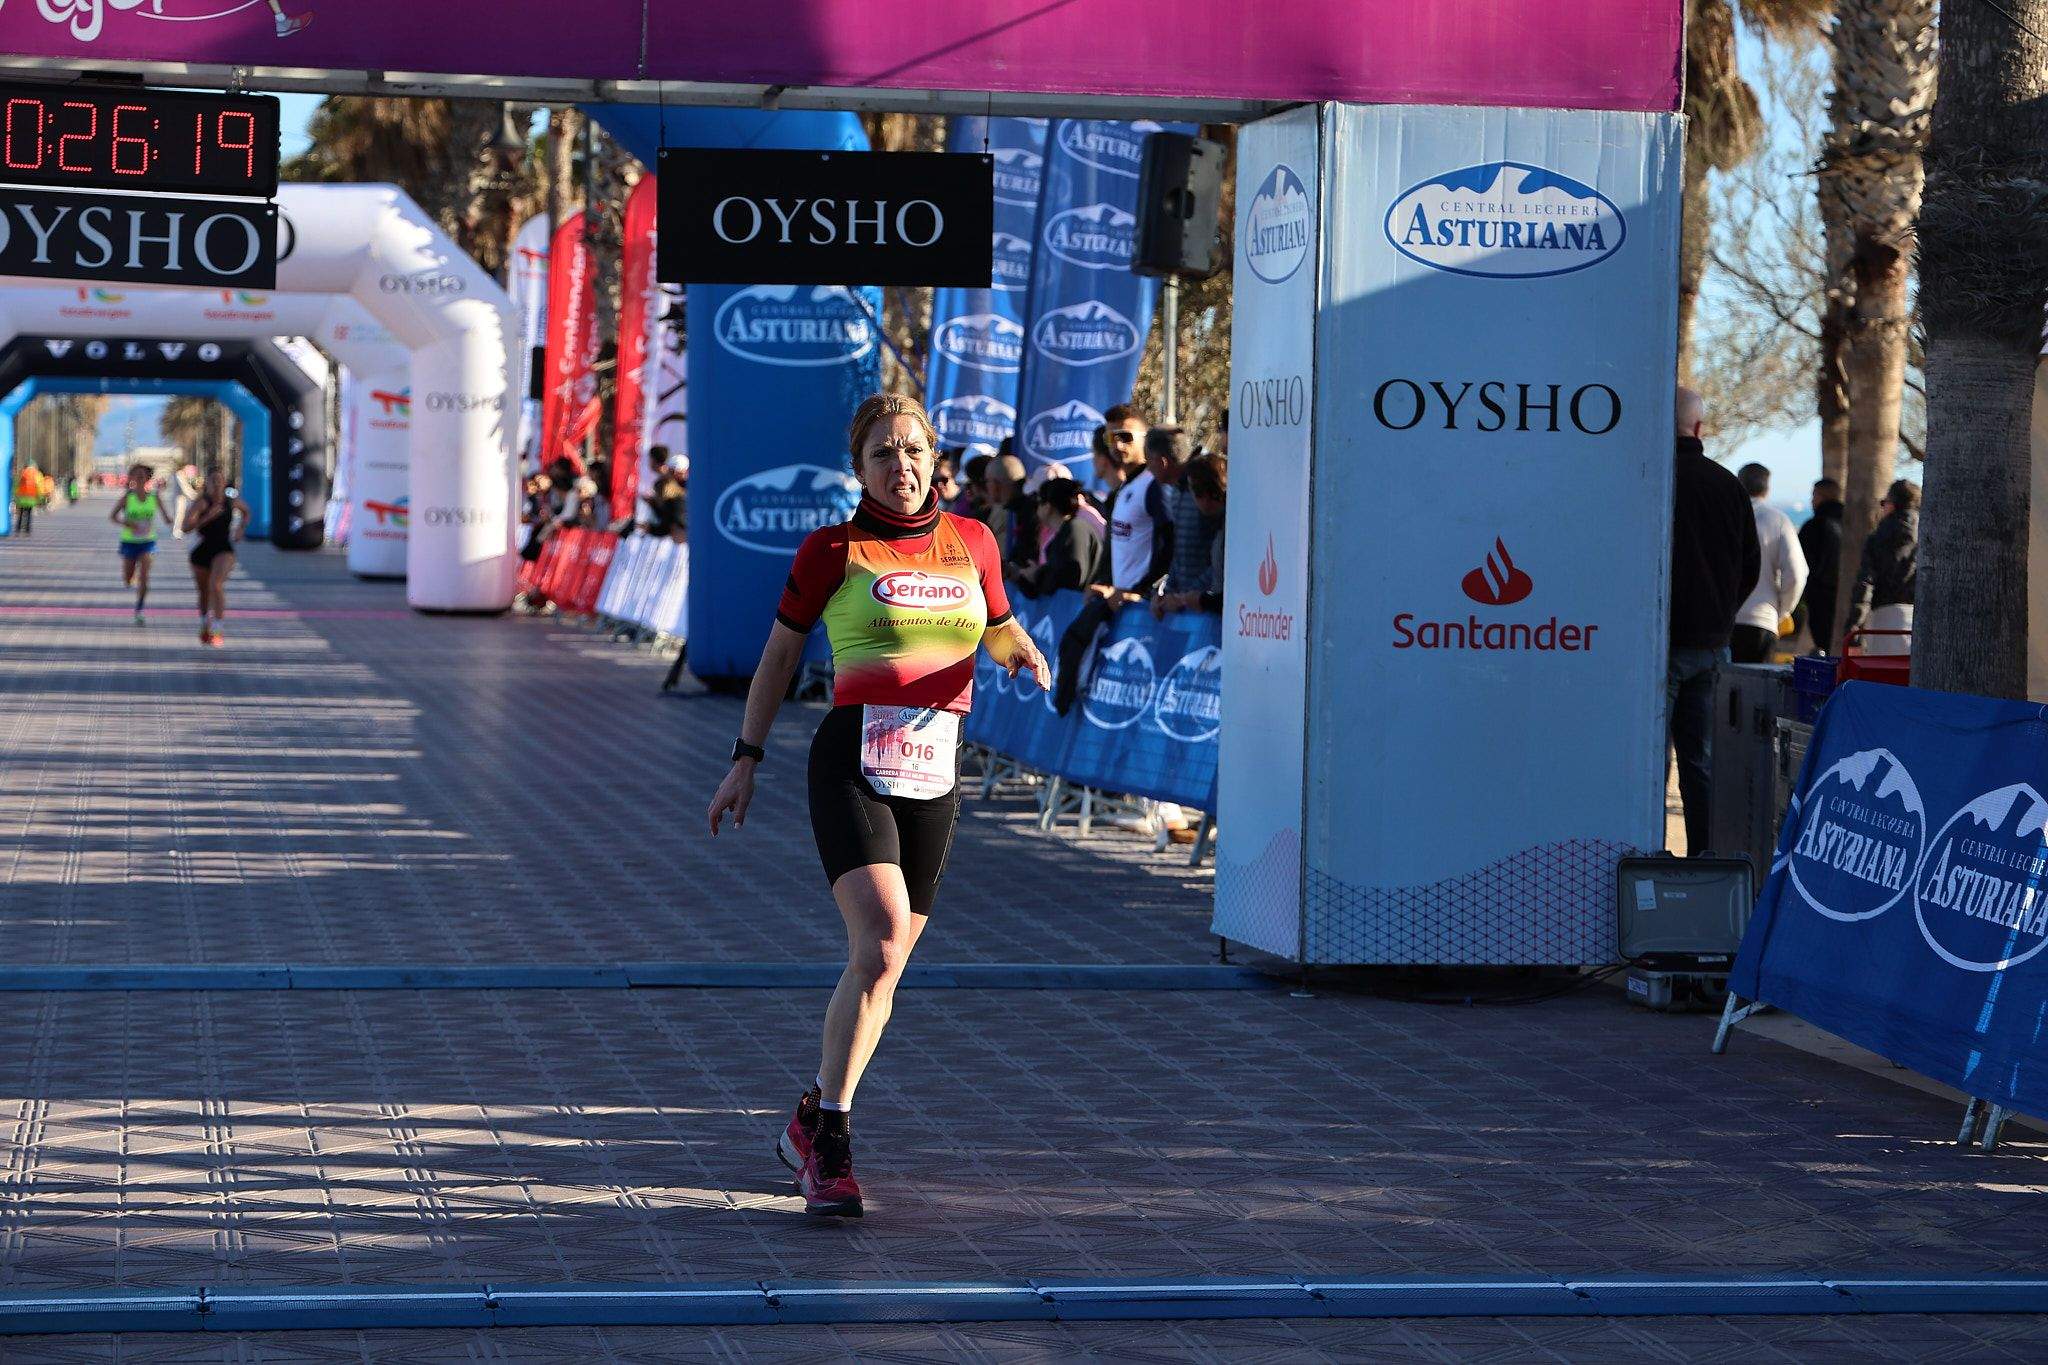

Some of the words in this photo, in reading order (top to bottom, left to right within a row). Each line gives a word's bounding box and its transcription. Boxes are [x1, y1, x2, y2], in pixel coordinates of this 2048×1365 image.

[713, 196, 944, 246] OYSHO
[1402, 202, 1608, 250] ASTURIANA
[1440, 200, 1515, 213] CENTRAL
[1524, 202, 1600, 216] LECHERA
[0, 203, 261, 276] YSHO
[1250, 214, 1306, 256] ASTURIANA
[44, 339, 222, 361] VOLVO
[1240, 375, 1304, 430] OYSHO
[1373, 379, 1622, 434] OYSHO
[883, 578, 965, 599] Serrano
[867, 616, 933, 628] Alimentos
[936, 616, 951, 626] de
[954, 617, 978, 632] Hoy
[1238, 603, 1293, 641] Santander
[1392, 613, 1599, 651] Santander
[901, 741, 935, 761] 016
[1793, 794, 1906, 891] ASTURIANA
[1960, 838, 2007, 865] CENTRAL
[2009, 852, 2047, 877] LECHE
